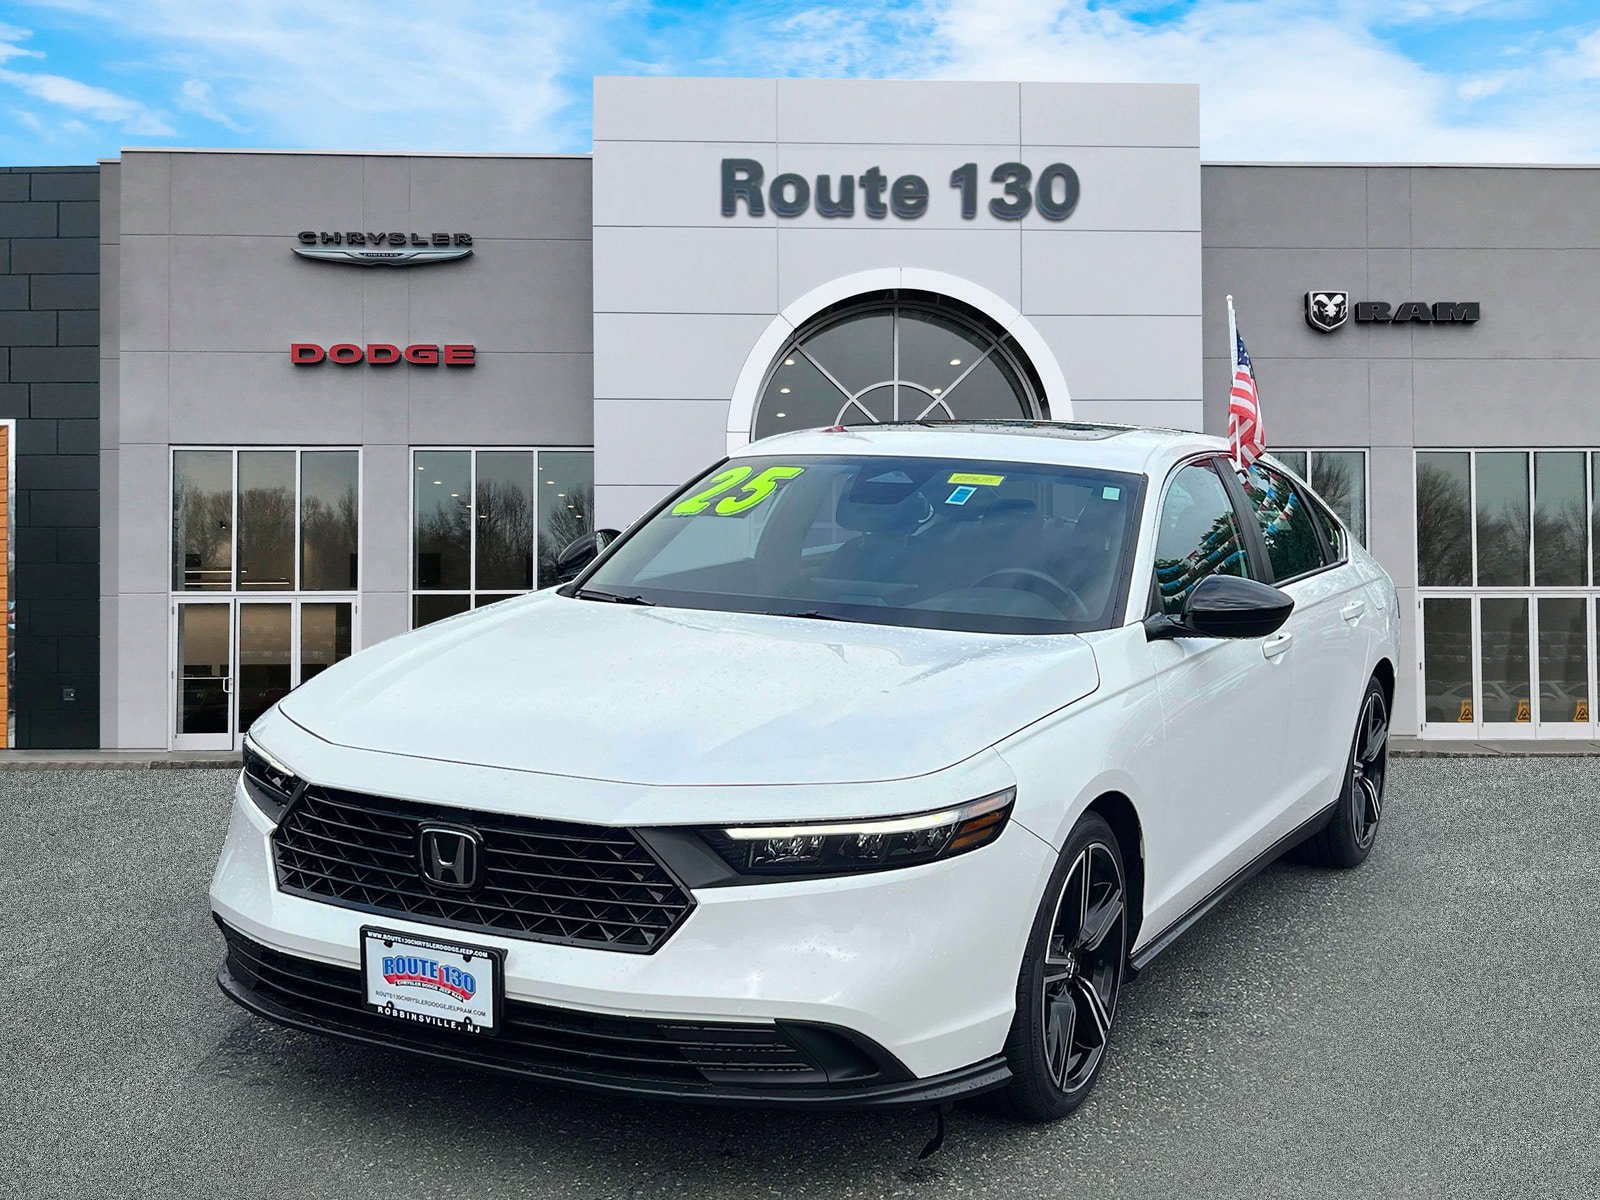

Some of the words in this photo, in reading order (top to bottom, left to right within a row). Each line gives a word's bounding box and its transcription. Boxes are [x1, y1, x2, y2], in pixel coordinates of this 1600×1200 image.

[720, 157, 929, 218] Route
[950, 161, 1081, 221] 130
[297, 231, 475, 246] CHRYSLER
[1354, 301, 1480, 324] RAM
[290, 343, 476, 366] DODGE
[671, 465, 805, 516] 25
[382, 955, 439, 979] ROUTE
[441, 964, 476, 994] 130
[377, 1006, 462, 1031] ROBBINSVILLE,
[467, 1024, 481, 1034] NJ
